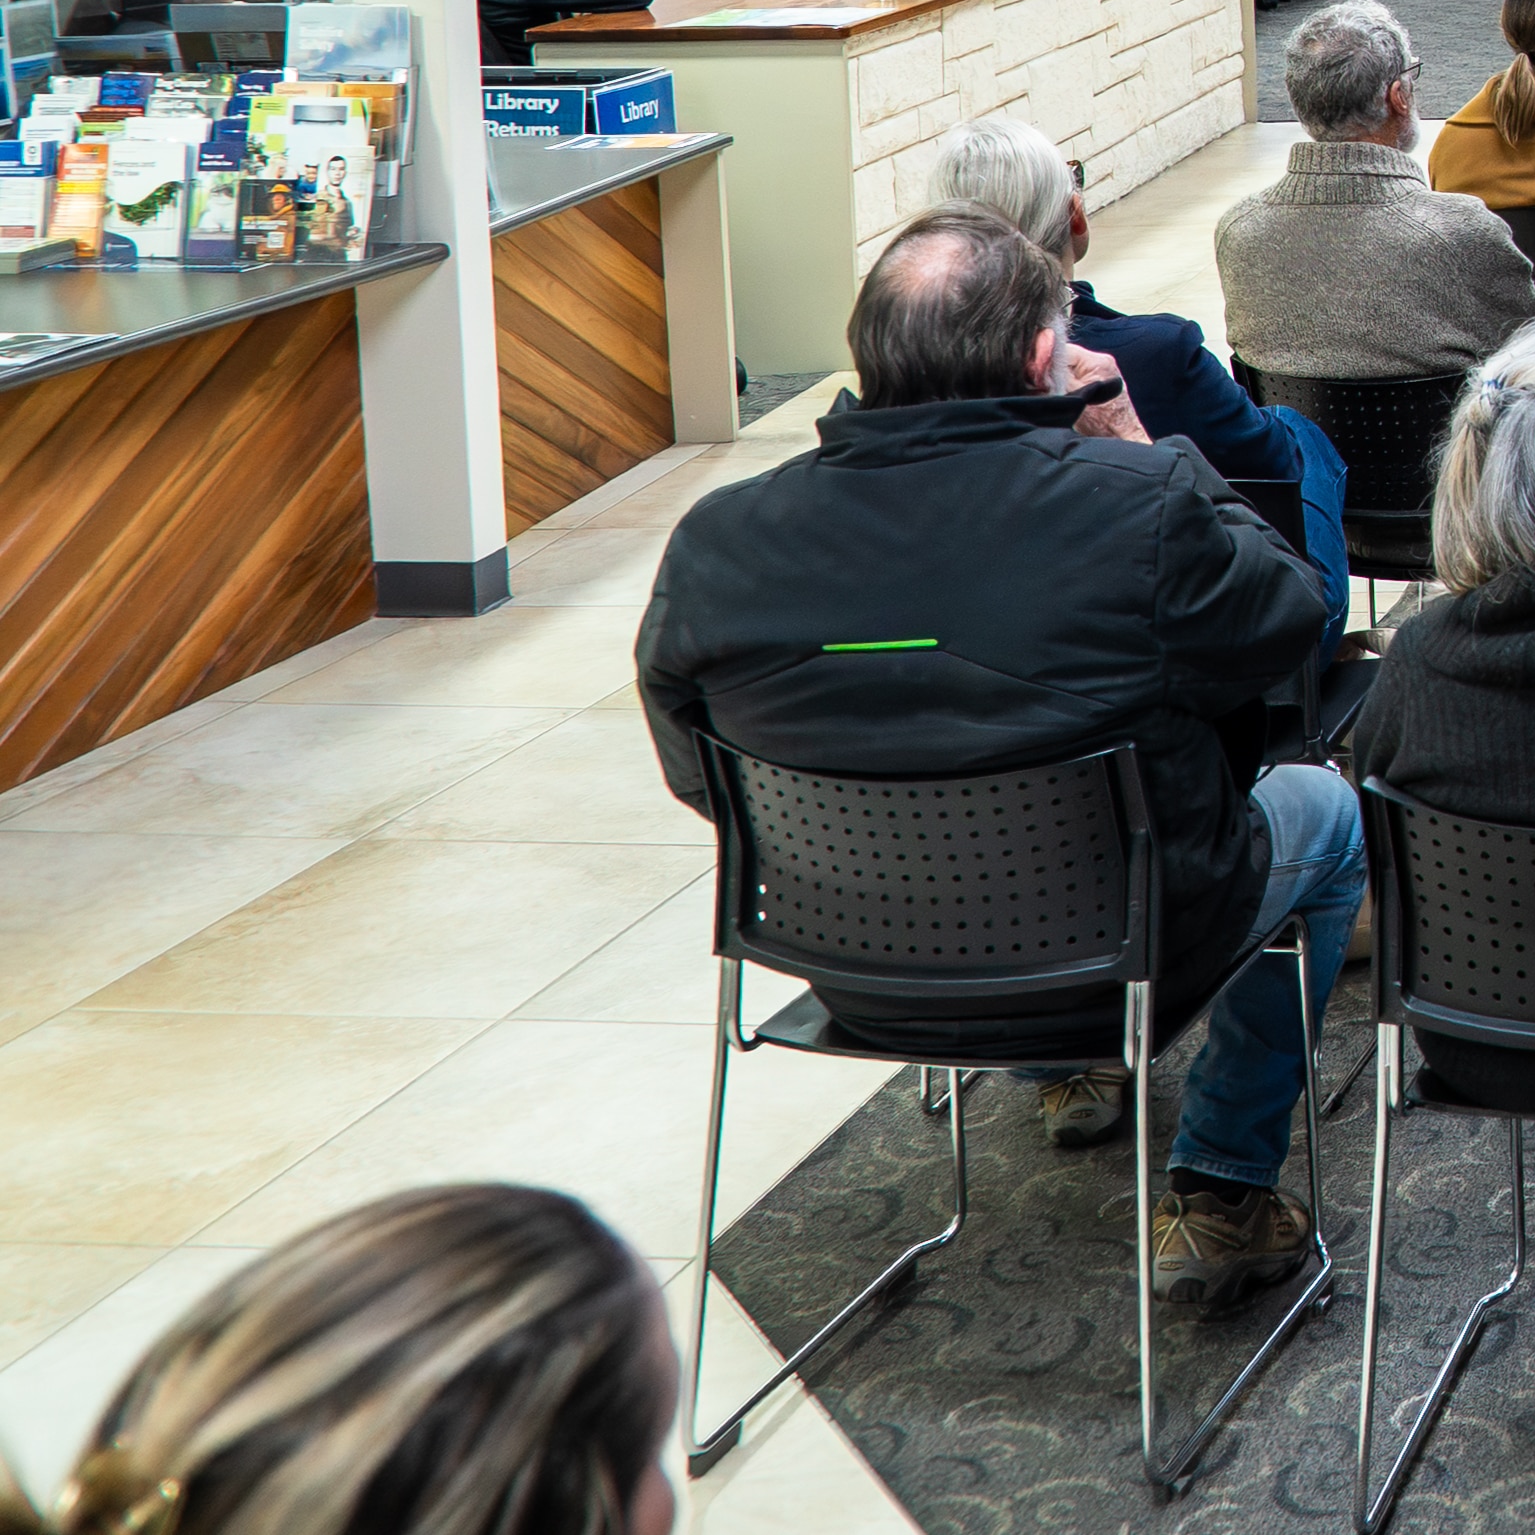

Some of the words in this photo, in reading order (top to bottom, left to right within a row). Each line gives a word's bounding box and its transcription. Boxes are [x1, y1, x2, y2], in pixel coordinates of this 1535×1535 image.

[484, 92, 560, 114] Library
[620, 97, 659, 124] Library
[485, 119, 561, 137] Returns
